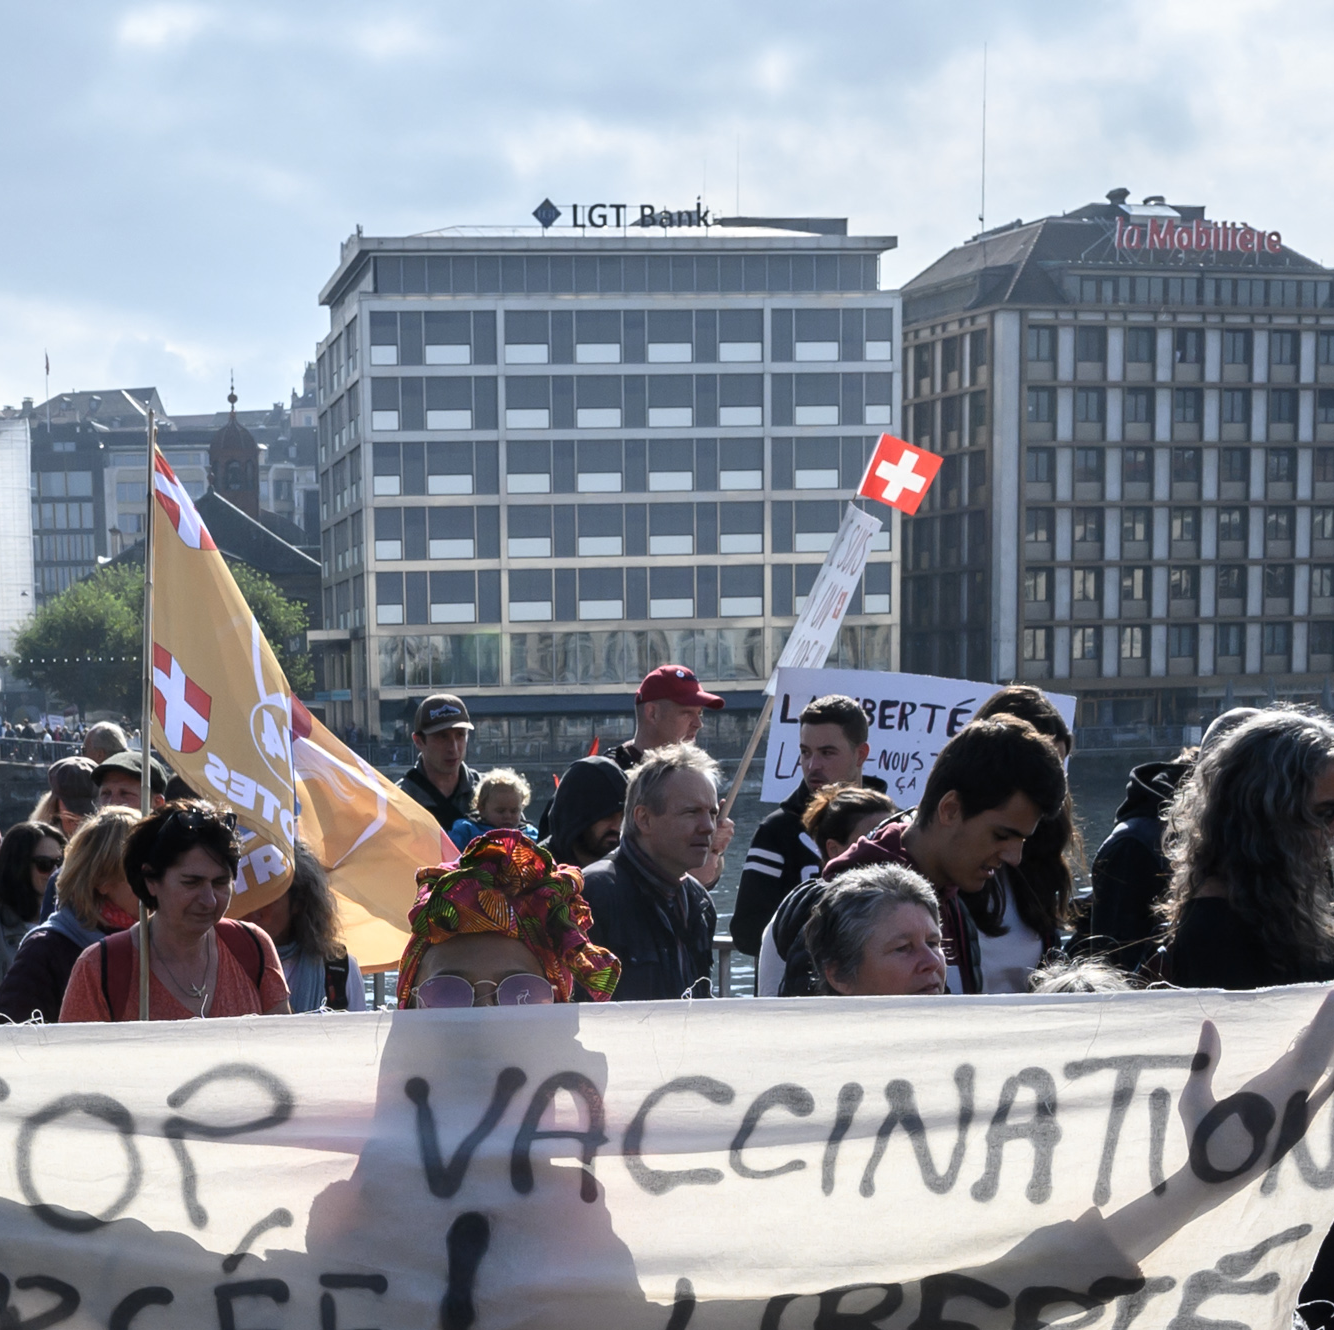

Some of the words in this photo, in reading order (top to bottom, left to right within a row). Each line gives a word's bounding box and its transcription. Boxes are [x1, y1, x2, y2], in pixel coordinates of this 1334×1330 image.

[572, 203, 627, 228] LGT
[639, 203, 713, 228] Bank
[1114, 216, 1141, 250] la
[1147, 218, 1282, 254] Mobilière
[857, 697, 977, 738] BERTÉ
[894, 776, 916, 795] ÇA
